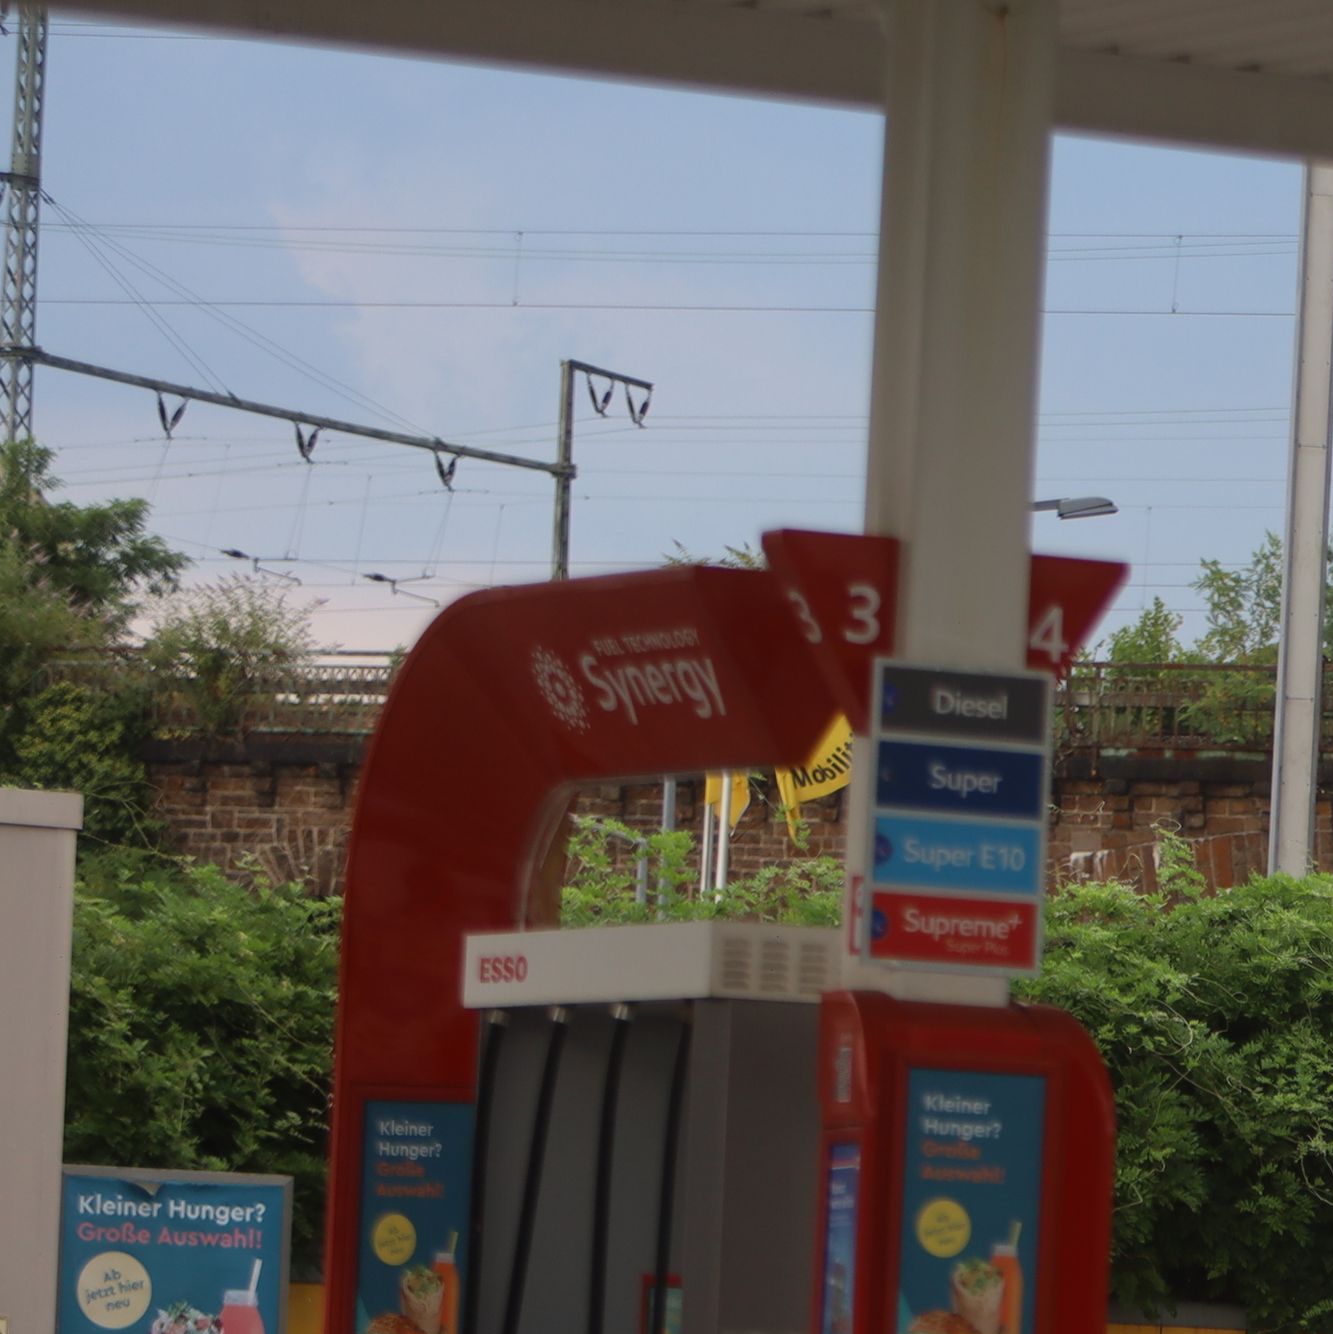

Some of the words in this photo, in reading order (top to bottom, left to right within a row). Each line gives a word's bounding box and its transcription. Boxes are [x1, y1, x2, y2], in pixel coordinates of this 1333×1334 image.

[844, 585, 881, 645] 3
[1029, 605, 1069, 663] 4
[580, 655, 726, 725] Synergy
[935, 690, 1009, 720] Diesel
[930, 764, 1003, 799] Super
[904, 839, 974, 871] Super
[980, 845, 1026, 871] E10
[478, 956, 528, 983] ESSO
[924, 1093, 992, 1116] Kleiner
[380, 1121, 434, 1138] Kleiner
[923, 1117, 1003, 1141] Hunger?
[380, 1141, 443, 1161] Hunger?
[79, 1194, 162, 1218] Kleiner
[169, 1200, 267, 1226] Hunger?
[77, 1221, 151, 1245] Große
[157, 1226, 263, 1249] Auswahl!
[118, 1279, 145, 1293] hier
